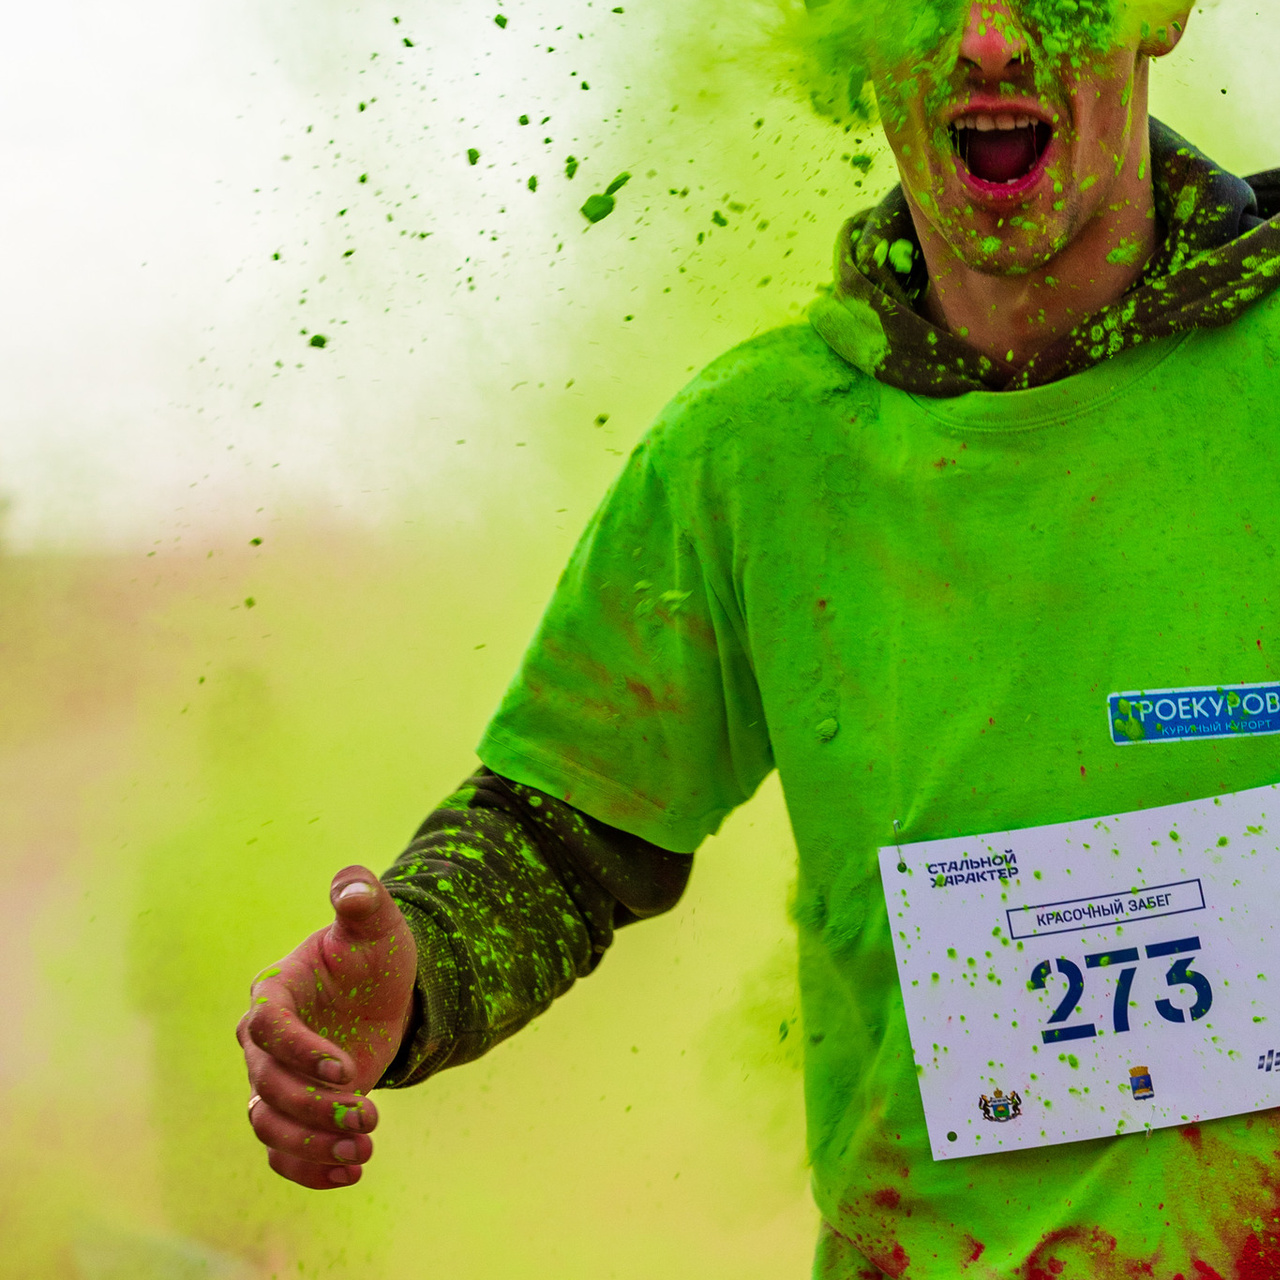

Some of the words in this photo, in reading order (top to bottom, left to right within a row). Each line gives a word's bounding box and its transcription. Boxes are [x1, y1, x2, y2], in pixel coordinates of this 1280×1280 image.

[927, 849, 1017, 874] СТАЛЬНОЙ
[930, 867, 1019, 888] ХАРАКТЕР
[1036, 899, 1124, 926] КРАСОЧНЫЙ
[1128, 893, 1172, 912] ЗАБЕГ
[1030, 936, 1213, 1044] 273
